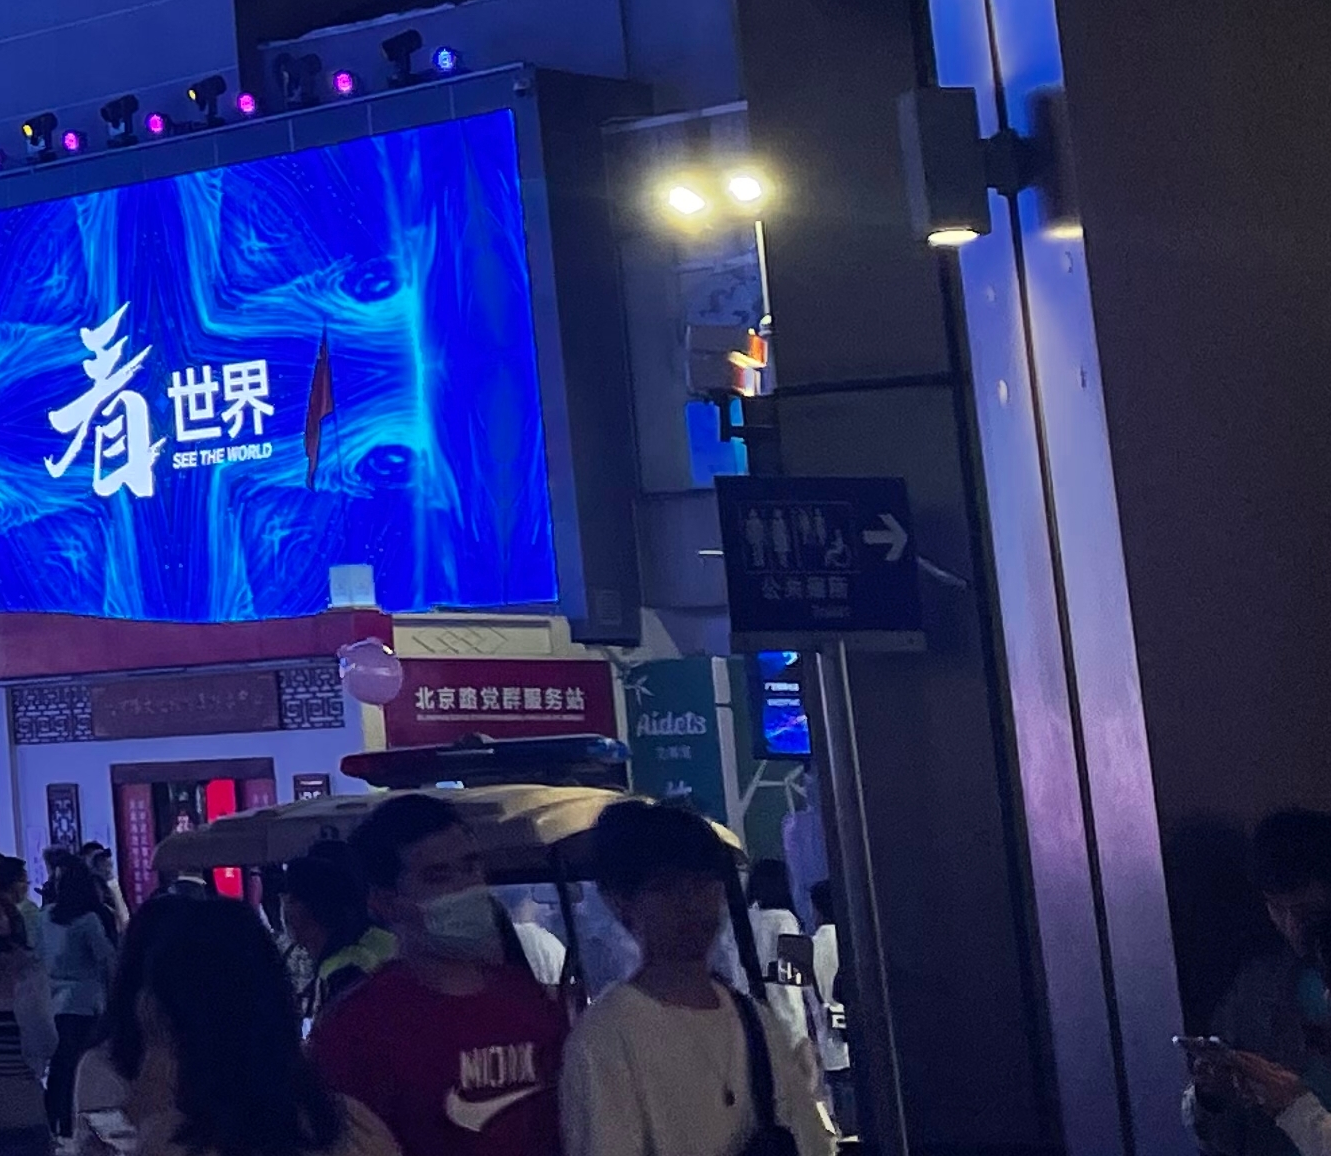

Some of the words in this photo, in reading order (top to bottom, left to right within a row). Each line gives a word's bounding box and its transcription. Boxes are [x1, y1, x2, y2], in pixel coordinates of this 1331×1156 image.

[172, 451, 198, 469] SEE
[200, 448, 225, 466] THE
[228, 442, 273, 463] WORLD
[415, 686, 586, 711] 北京路党群服务站
